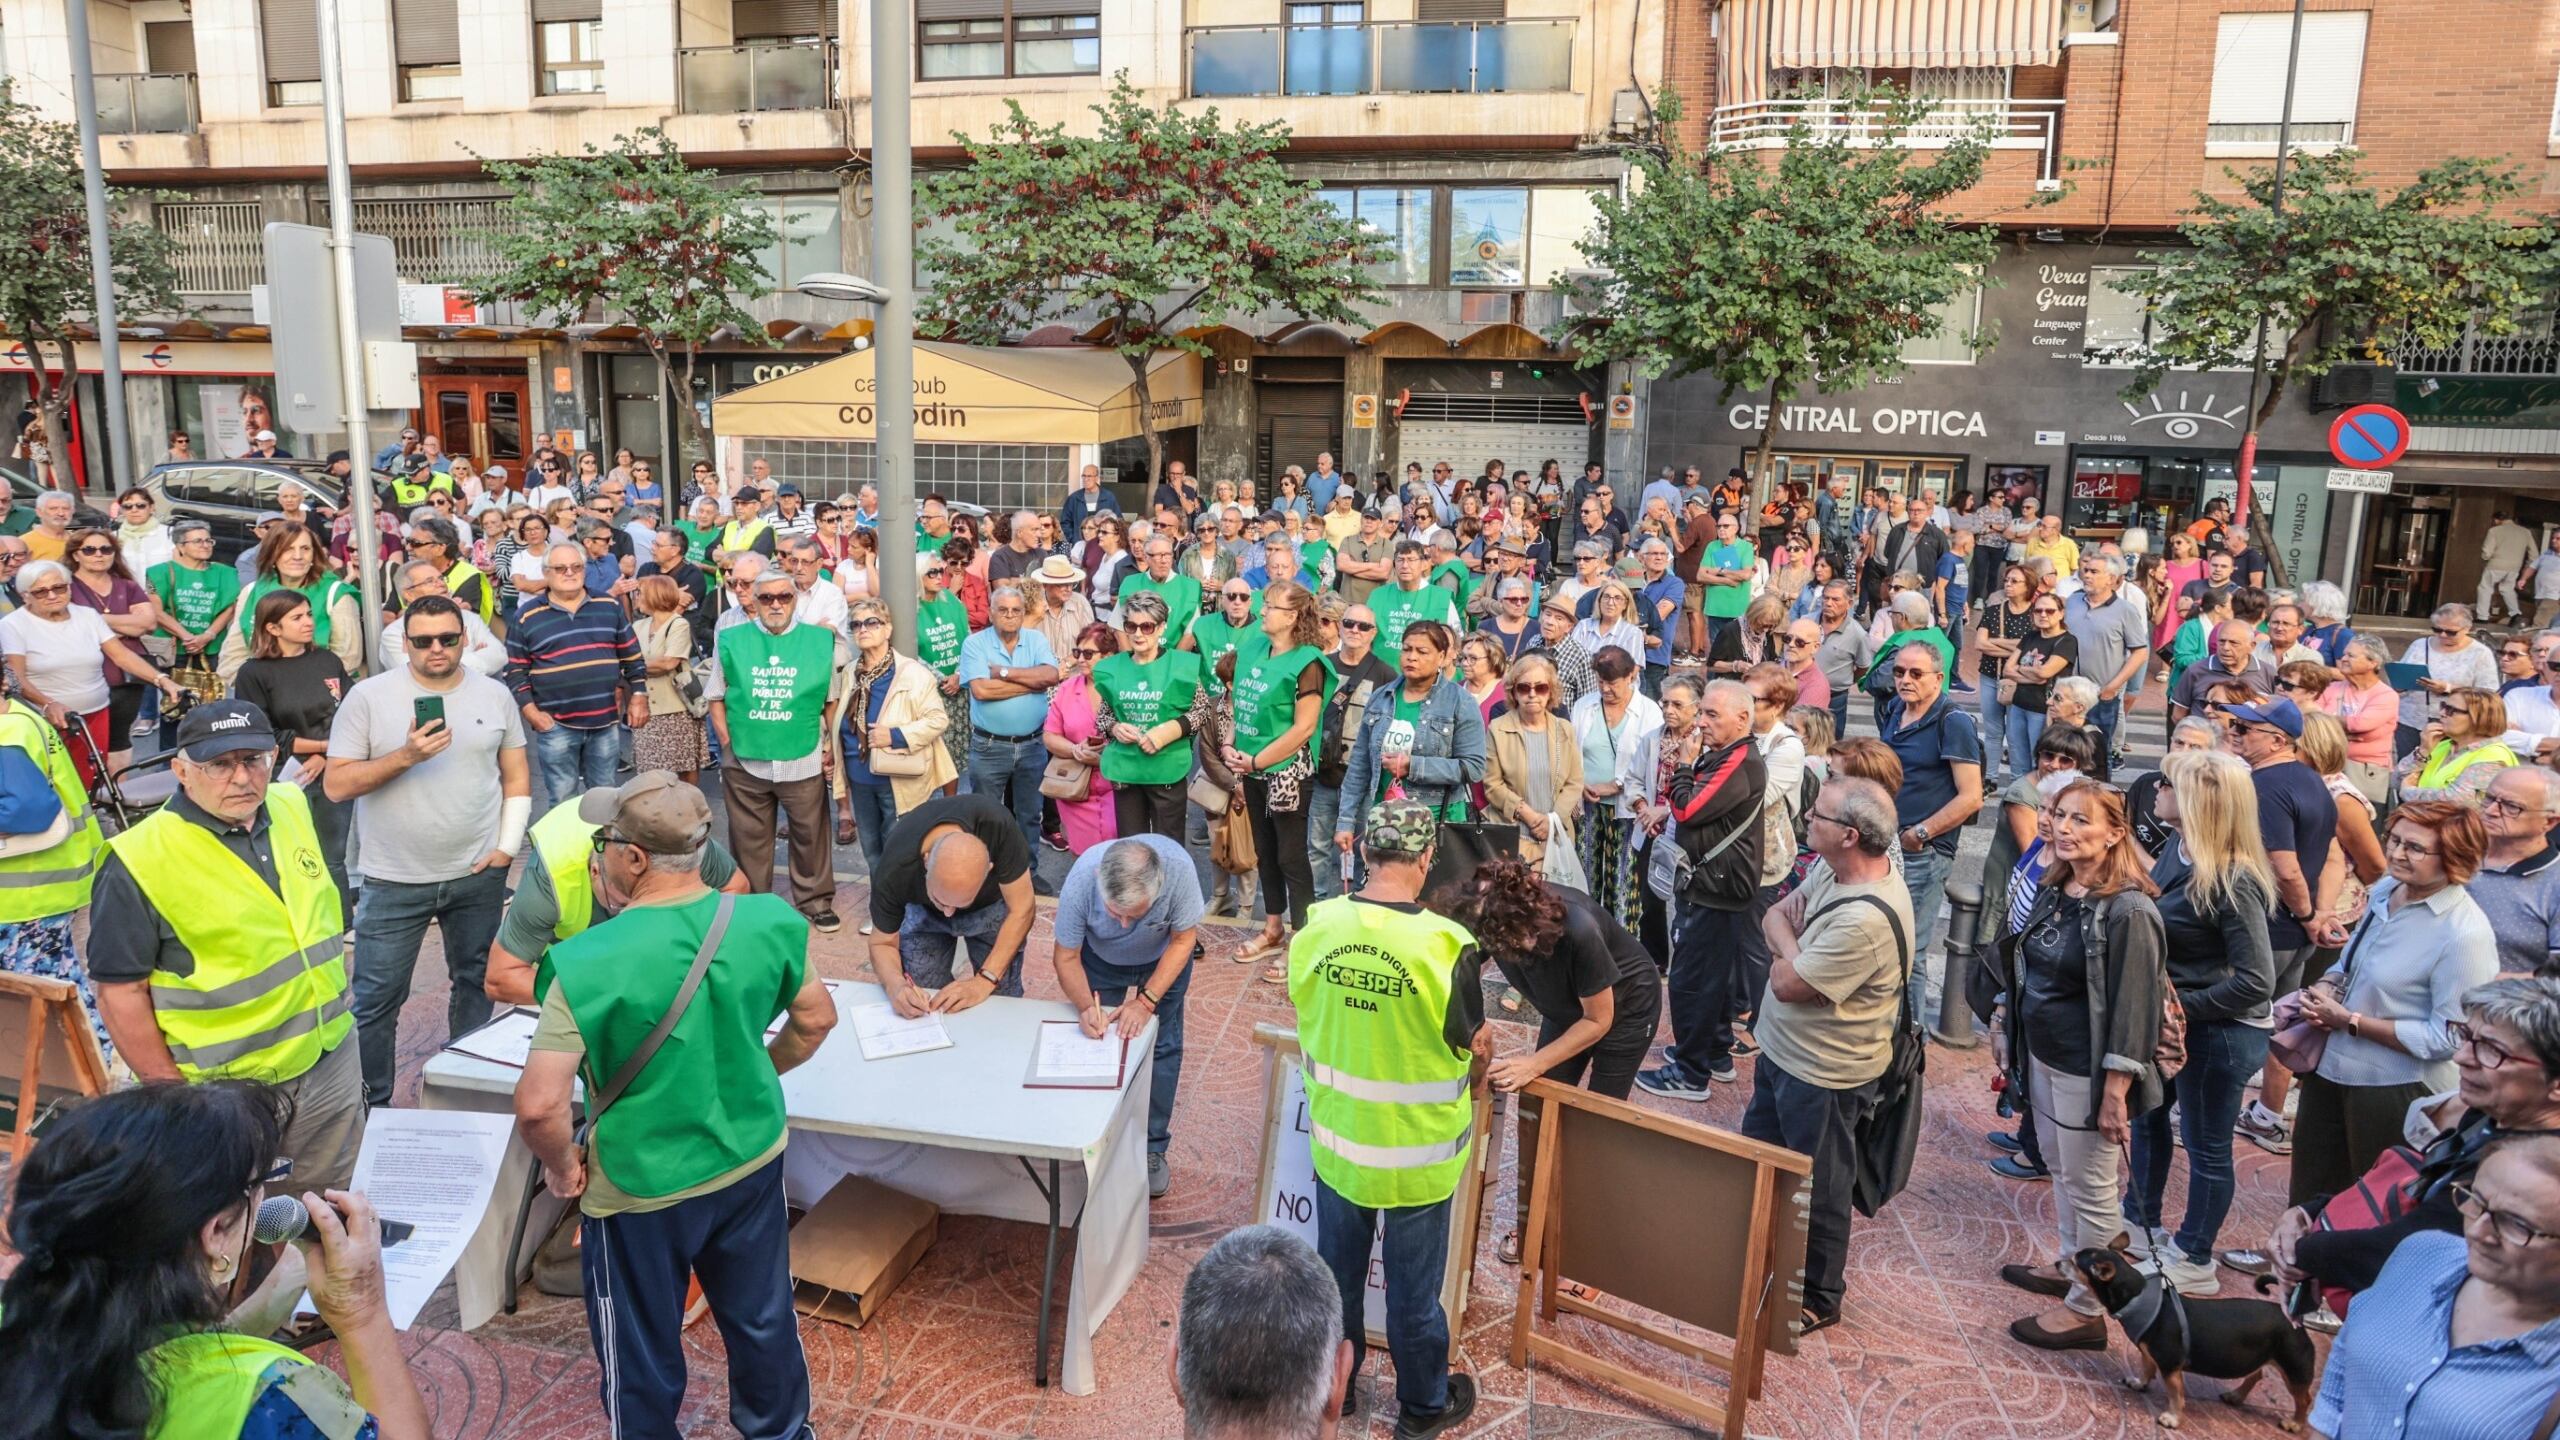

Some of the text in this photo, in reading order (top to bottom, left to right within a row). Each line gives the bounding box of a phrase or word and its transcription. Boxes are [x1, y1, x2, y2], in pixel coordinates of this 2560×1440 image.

[2038, 265, 2087, 284] Vera
[2036, 288, 2088, 311] Gran
[2033, 319, 2082, 331] Language
[2032, 336, 2067, 346] Center
[839, 402, 966, 427] codin
[1729, 404, 1987, 437] CENTRAL OPTICA
[2084, 434, 2108, 442] Desde
[2286, 493, 2309, 589] CENTRAL OPTICA
[751, 666, 798, 678] SANIDAD
[752, 686, 793, 699] PÚBLICA
[1119, 690, 1163, 701] SANIDAD
[761, 700, 783, 710] Y DE
[748, 709, 793, 721] CALIDAD
[211, 717, 247, 732] PUMA
[1234, 722, 1260, 736] ALIDAD
[1387, 731, 1412, 746] TOP
[1313, 943, 1420, 996] PENSIONES DIGNAS
[1327, 965, 1402, 996] COESPE
[1345, 996, 1379, 1013] ELDA
[1275, 1190, 1312, 1225] NO
